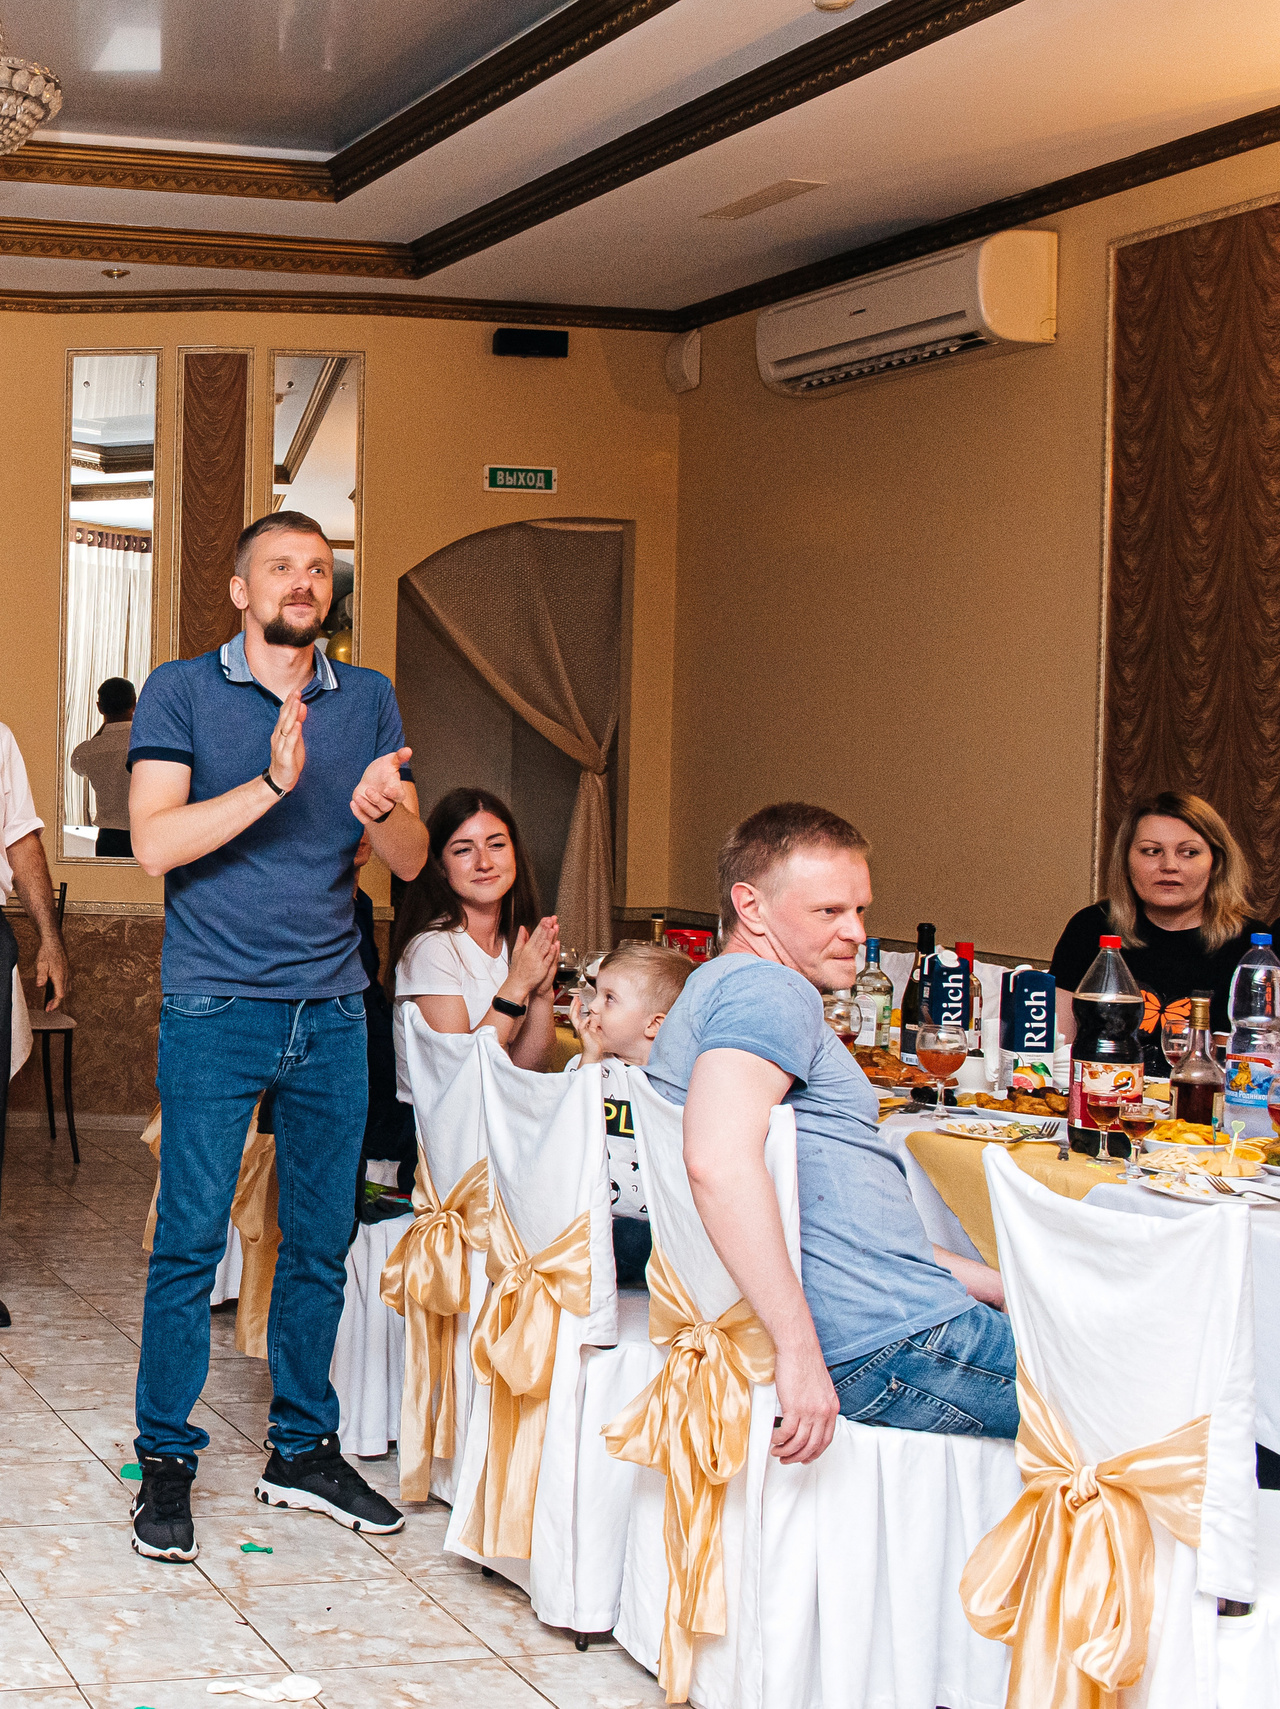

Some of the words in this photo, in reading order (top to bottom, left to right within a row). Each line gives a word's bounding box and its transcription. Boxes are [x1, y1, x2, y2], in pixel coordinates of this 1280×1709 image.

[496, 471, 546, 489] ВЫХОД
[942, 973, 964, 1026] Rich
[1024, 990, 1047, 1048] Rich
